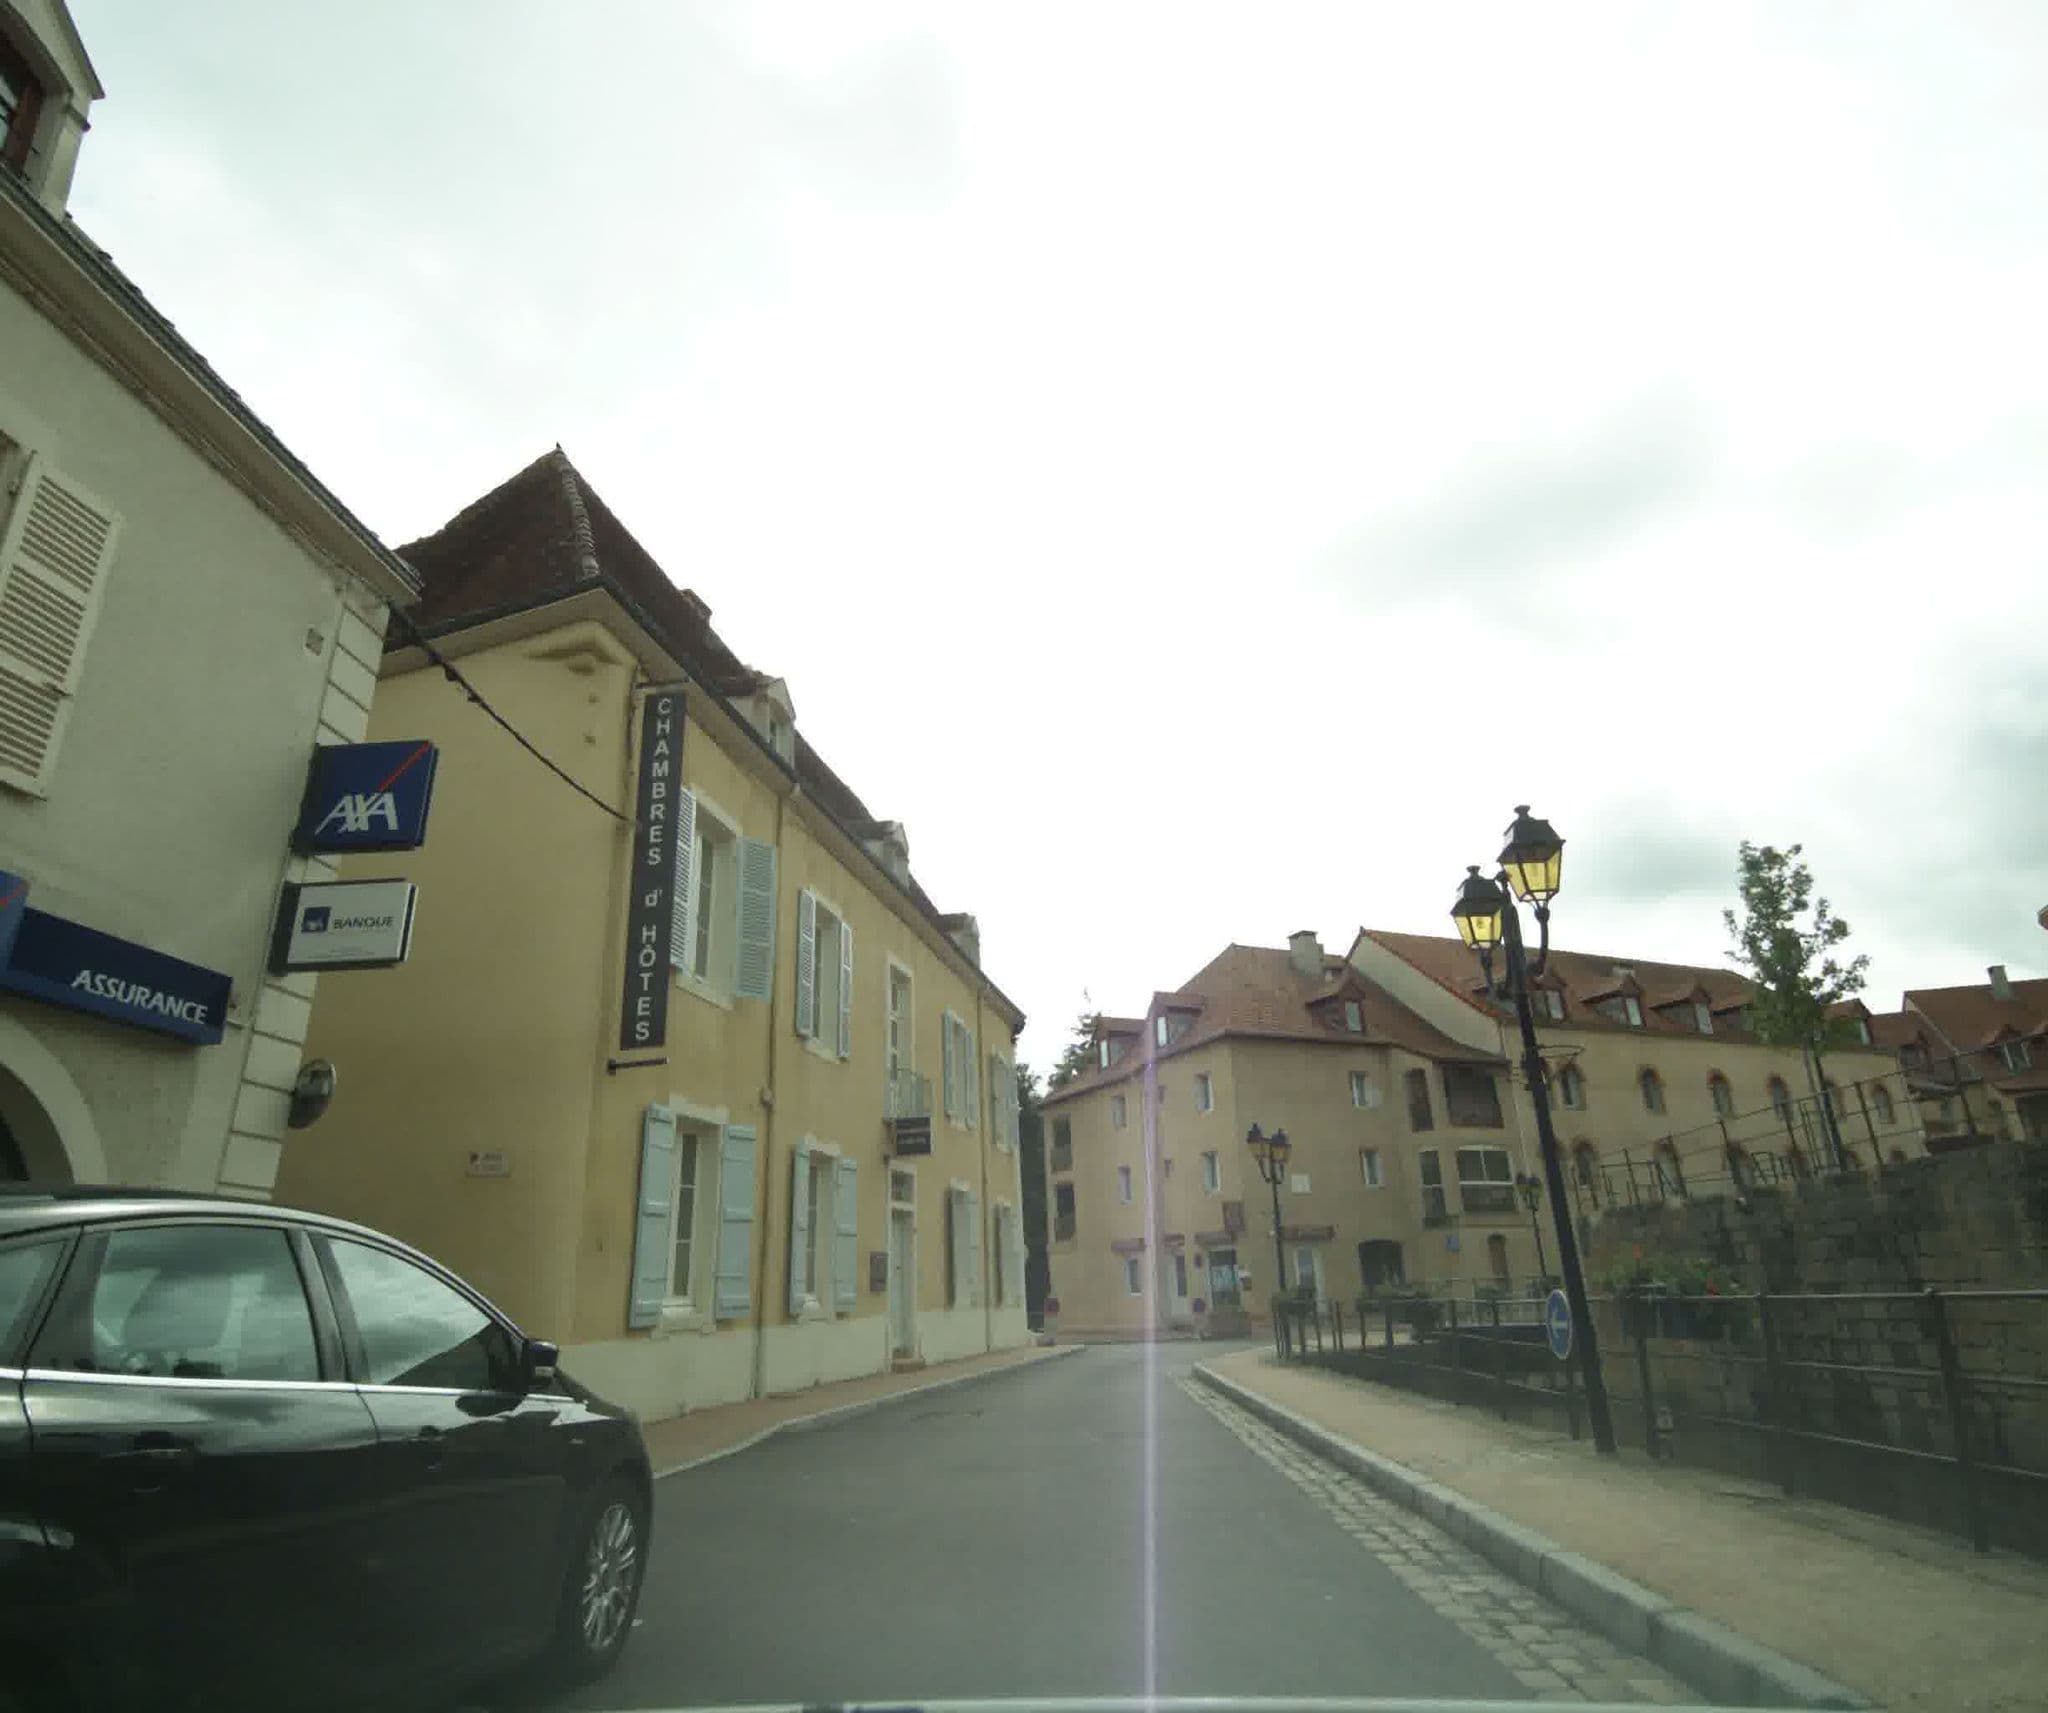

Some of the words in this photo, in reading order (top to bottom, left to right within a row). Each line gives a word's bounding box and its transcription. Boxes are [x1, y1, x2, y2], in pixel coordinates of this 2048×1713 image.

[647, 696, 671, 865] CHAMBRES
[314, 792, 399, 836] AXA
[333, 916, 394, 930] BANQUE
[71, 969, 209, 1025] ASSURANCE
[635, 924, 657, 1041] HÔTES
